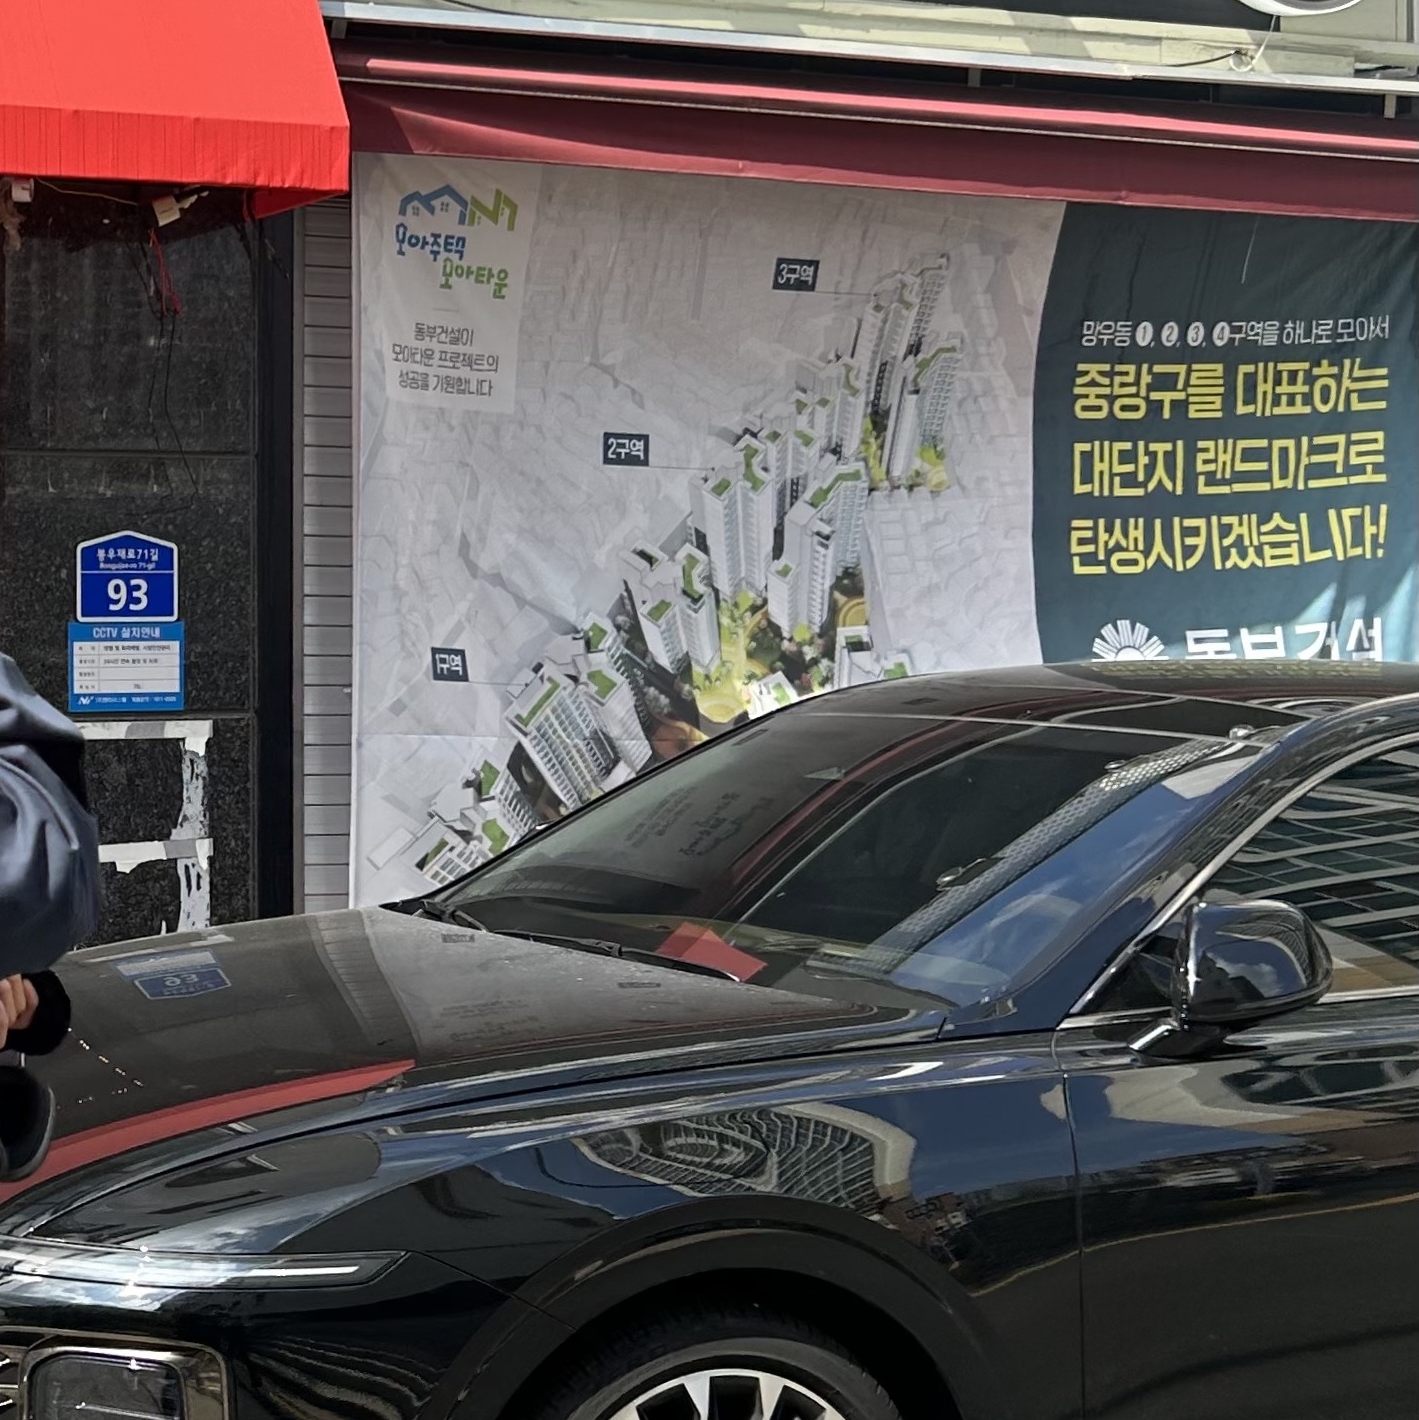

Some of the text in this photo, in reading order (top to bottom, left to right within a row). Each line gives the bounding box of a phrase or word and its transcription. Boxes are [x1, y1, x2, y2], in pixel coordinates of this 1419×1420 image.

[395, 222, 466, 262] 모아주택
[439, 257, 508, 300] 모아타운
[778, 263, 814, 286] 3구역
[414, 322, 474, 347] 동부건설이
[1082, 321, 1131, 346] 망우동
[1283, 319, 1333, 345] 하나로
[1336, 315, 1390, 343] 모아서
[392, 343, 499, 373] 모아타운 프로젝트의
[398, 370, 493, 397] 성공을 기원합니다
[1072, 357, 1389, 420] 중랑구를 대표하는
[607, 437, 644, 460] 2구역
[1072, 431, 1387, 497] 대단지 랜드마크로
[1070, 504, 1388, 575] 탄생시키겠습니다!
[107, 578, 148, 611] 93
[92, 627, 161, 639] CCTV 설치안내
[435, 653, 463, 676] 1구역
